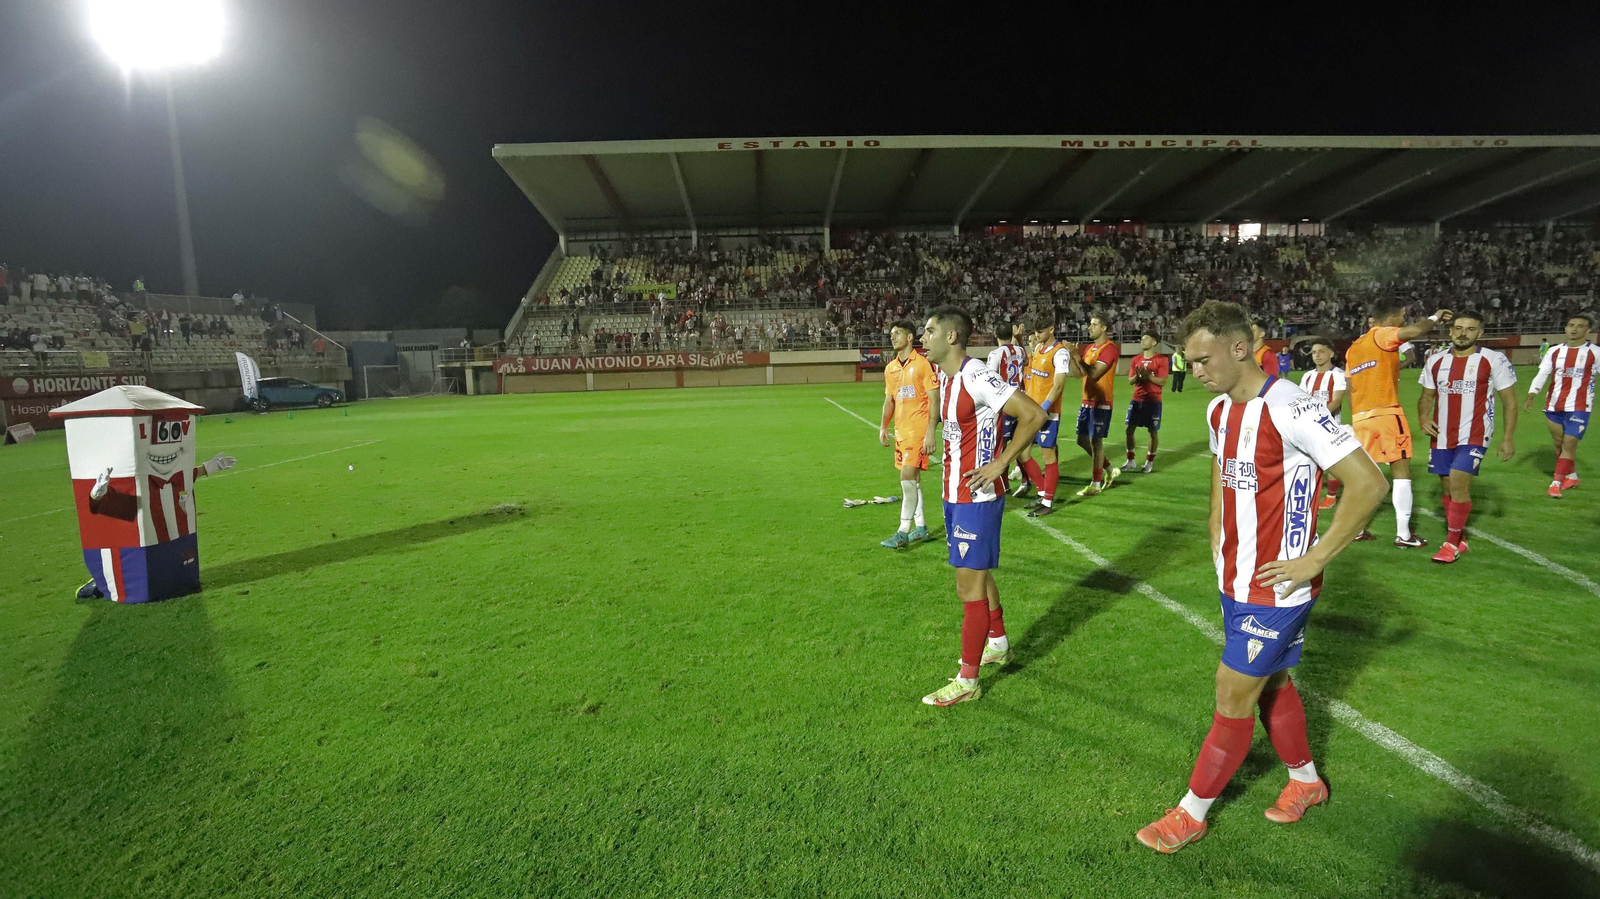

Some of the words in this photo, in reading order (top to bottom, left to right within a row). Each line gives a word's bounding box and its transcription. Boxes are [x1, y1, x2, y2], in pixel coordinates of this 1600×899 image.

[717, 140, 881, 150] ESTADIO
[1060, 139, 1264, 148] MUNICIPAL
[531, 358, 572, 371] JUAN
[574, 355, 642, 369] ANTONIO
[646, 354, 685, 367] PARA
[688, 350, 745, 367] SIEMPRE
[32, 376, 117, 393] HORIZONTE
[121, 375, 147, 386] SUR
[1289, 478, 1308, 548] ZPMC
